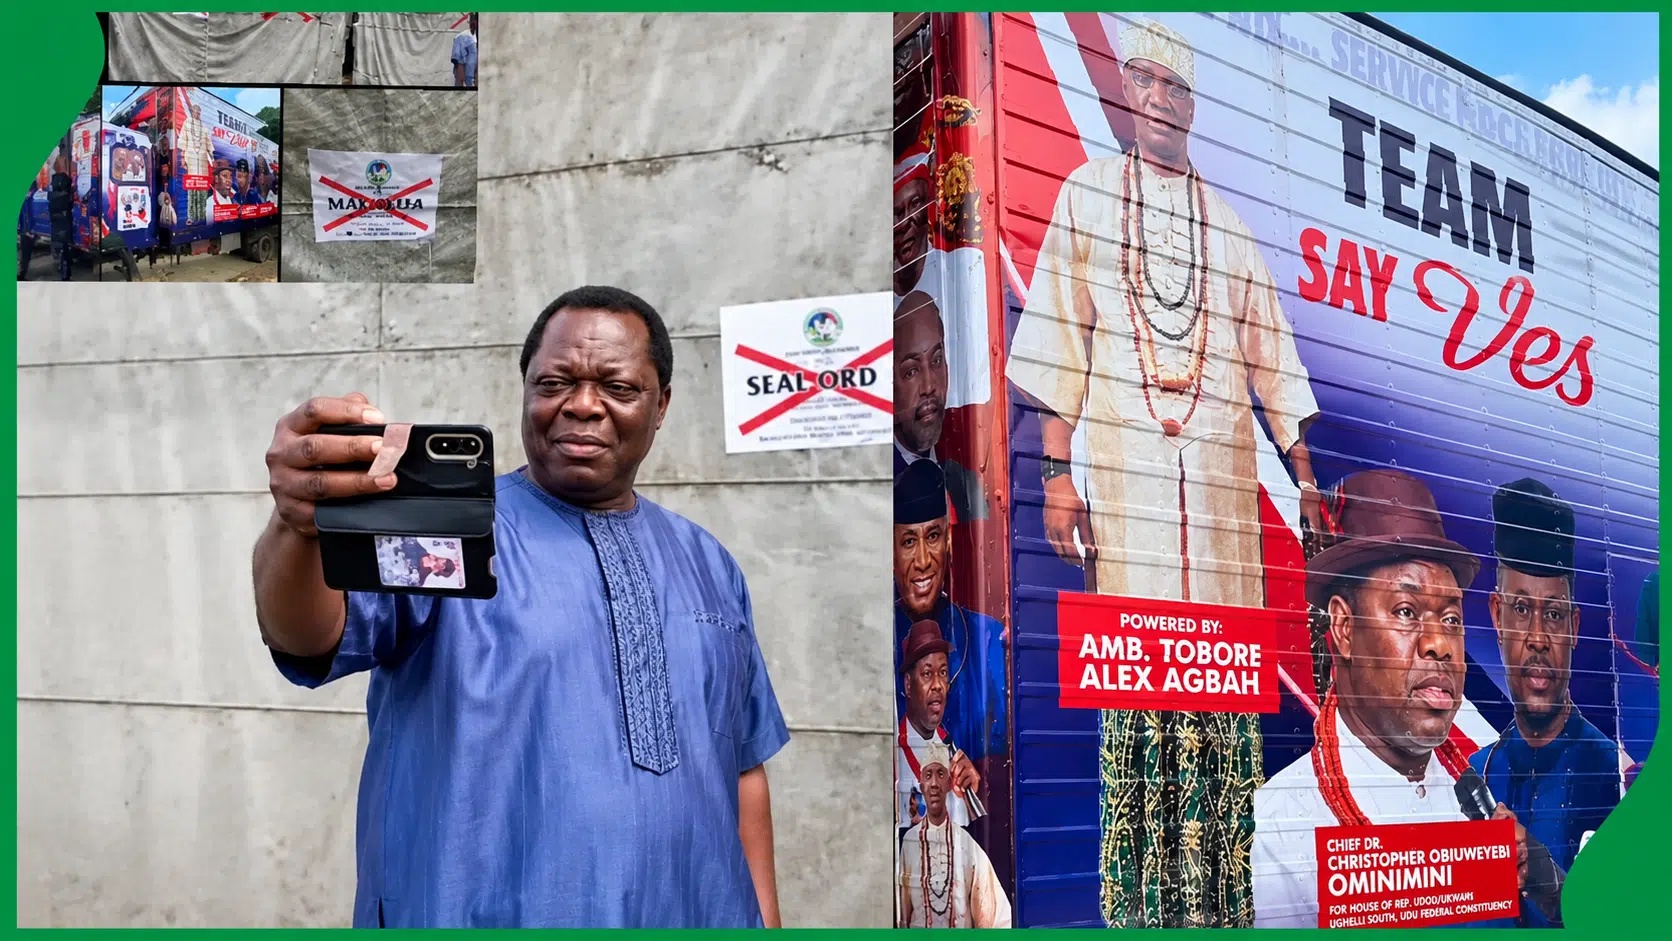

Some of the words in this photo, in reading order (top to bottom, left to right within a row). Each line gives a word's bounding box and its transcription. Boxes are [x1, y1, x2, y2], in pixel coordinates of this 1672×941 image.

[1329, 96, 1535, 274] TEAM
[1298, 228, 1398, 322] SAY
[747, 373, 808, 396] SEAL
[818, 367, 877, 390] ORD
[1120, 613, 1197, 632] POWERED
[1201, 619, 1223, 634] BY:
[1078, 633, 1150, 662] AMB.
[1159, 638, 1261, 667] TOBORE
[1079, 663, 1154, 691] ALEX
[1162, 667, 1260, 695] AGBAH
[1327, 838, 1361, 852] CHIEF
[1364, 837, 1383, 849] DR.
[1327, 853, 1425, 871] CHRISTOPHER
[1429, 845, 1511, 863] OBIUWEYEBI
[1328, 865, 1453, 896] OMINIMINI
[1329, 905, 1347, 915] FOR
[1350, 902, 1379, 914] HOUSE
[1381, 900, 1393, 910] OF
[1395, 898, 1412, 909] REP.
[1329, 916, 1366, 929] UGHELLI
[1368, 912, 1398, 924] SOUTH,
[1400, 910, 1418, 921] UDU
[1420, 906, 1454, 918] FEDERAL
[1456, 900, 1513, 915] CONSTITUENCY
